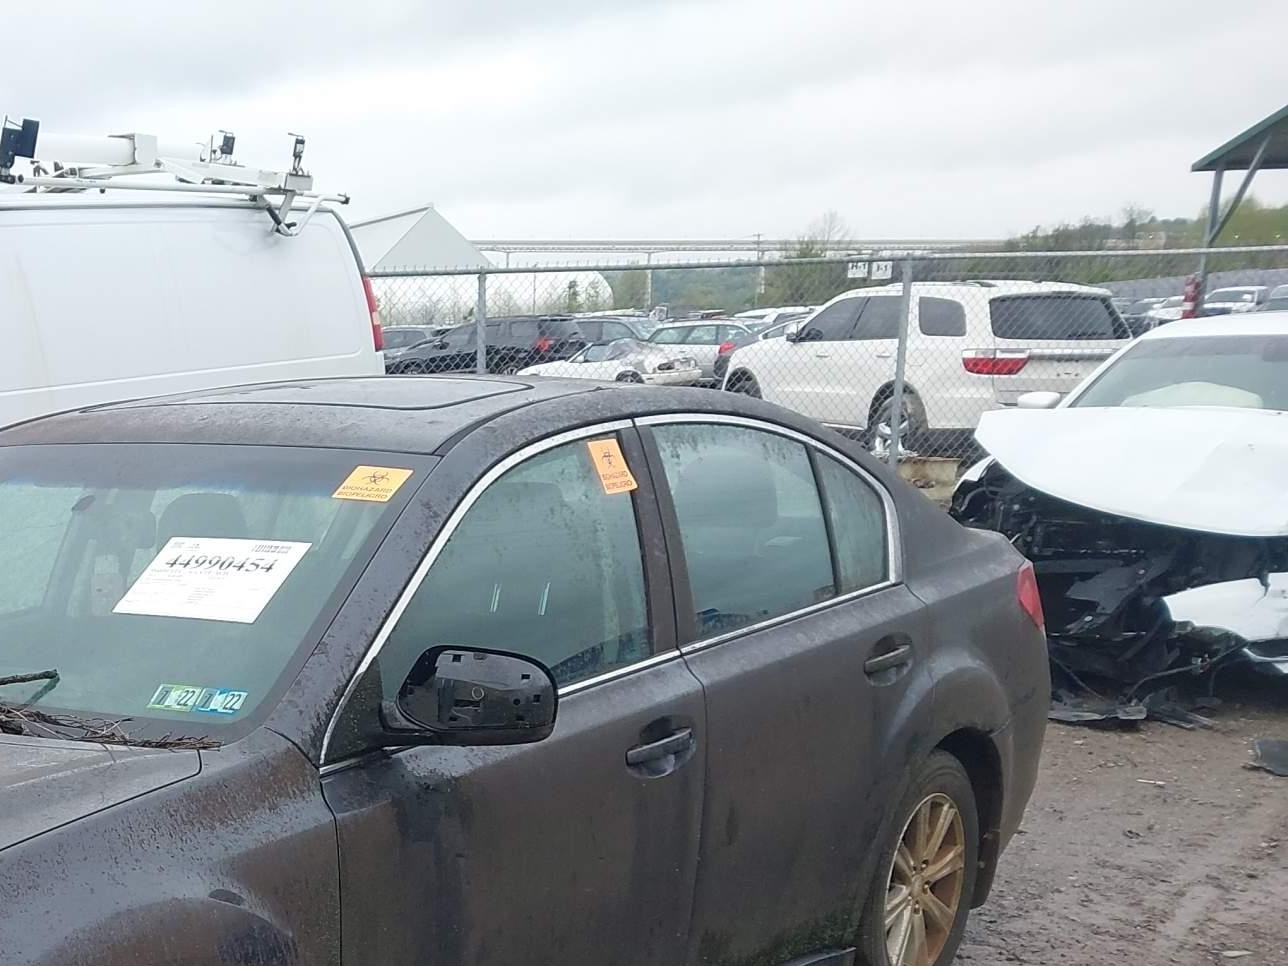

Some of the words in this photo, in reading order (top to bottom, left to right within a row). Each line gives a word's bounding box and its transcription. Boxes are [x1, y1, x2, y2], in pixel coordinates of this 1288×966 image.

[336, 491, 389, 500] BIOPELIGRO
[341, 485, 393, 494] BIOHAZARD
[165, 554, 279, 573] 44990454
[177, 689, 196, 706] 22
[223, 693, 242, 710] 22
